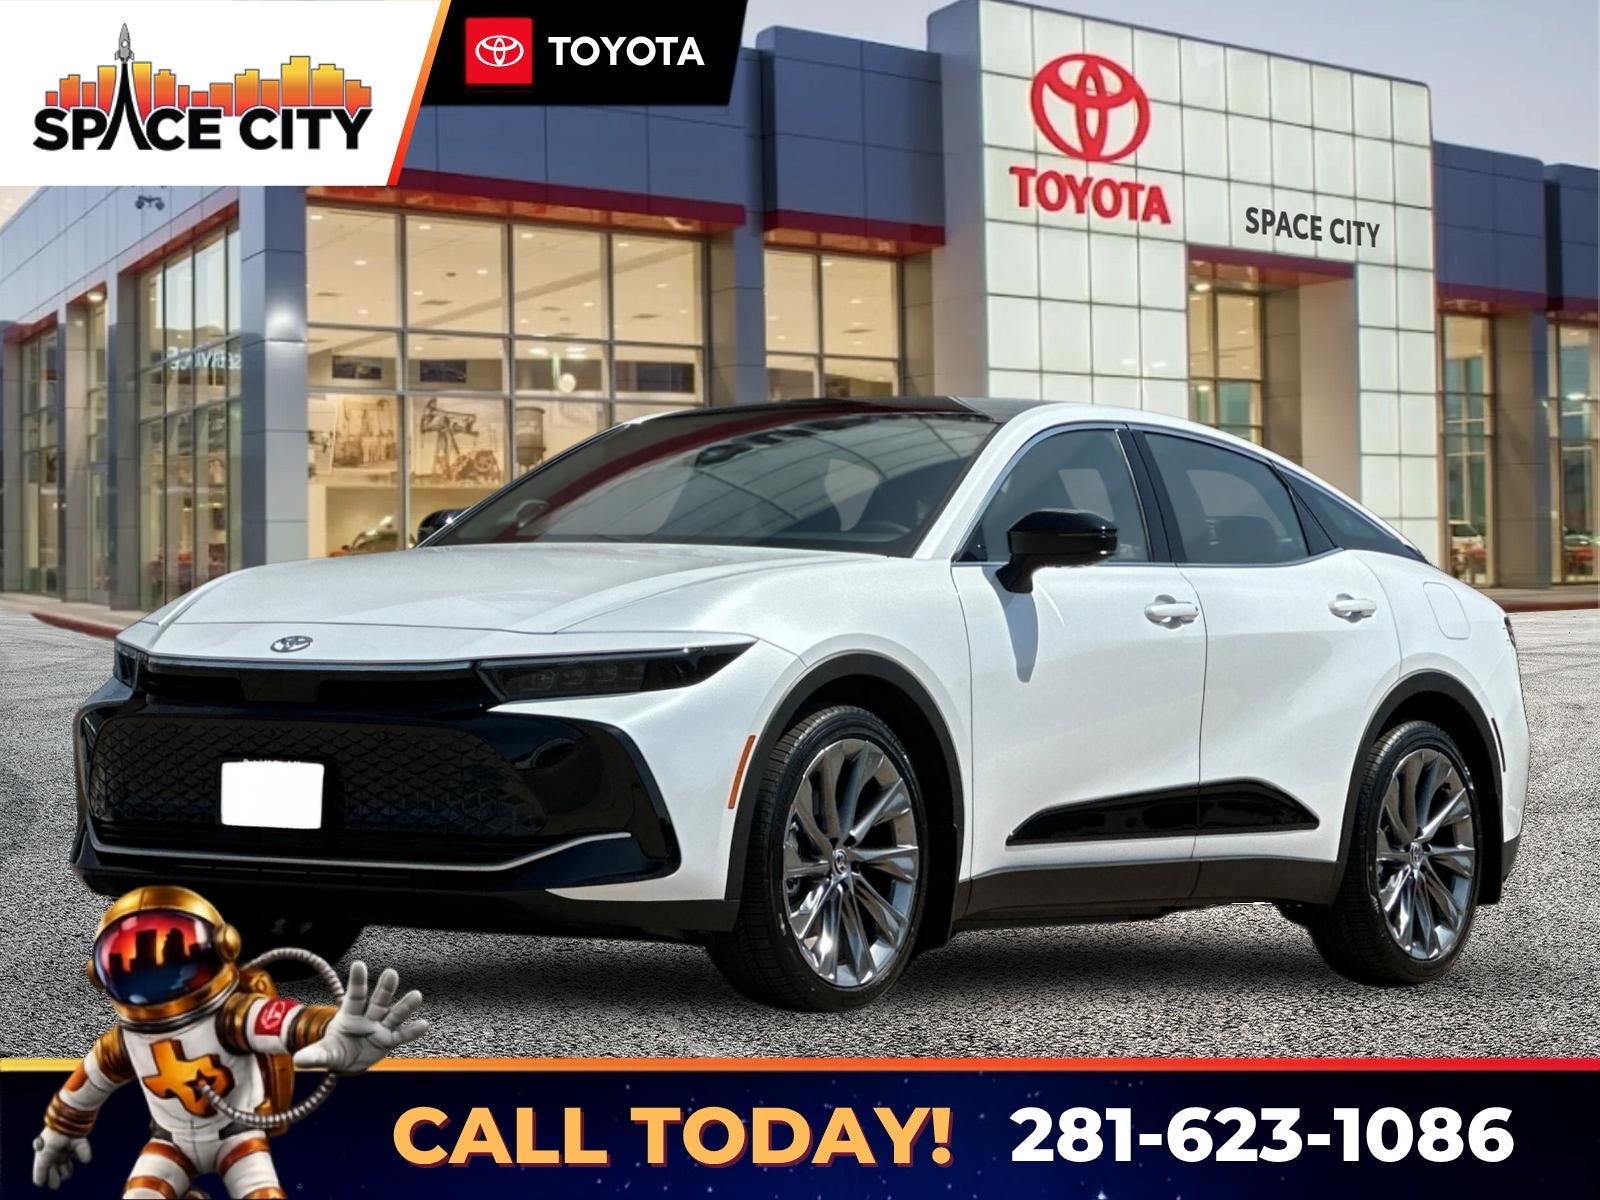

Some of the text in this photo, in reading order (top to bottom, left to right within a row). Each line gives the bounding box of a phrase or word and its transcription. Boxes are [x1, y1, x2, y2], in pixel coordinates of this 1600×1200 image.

[1009, 166, 1171, 225] TOYOTA
[1245, 206, 1381, 248] SPACE CITY
